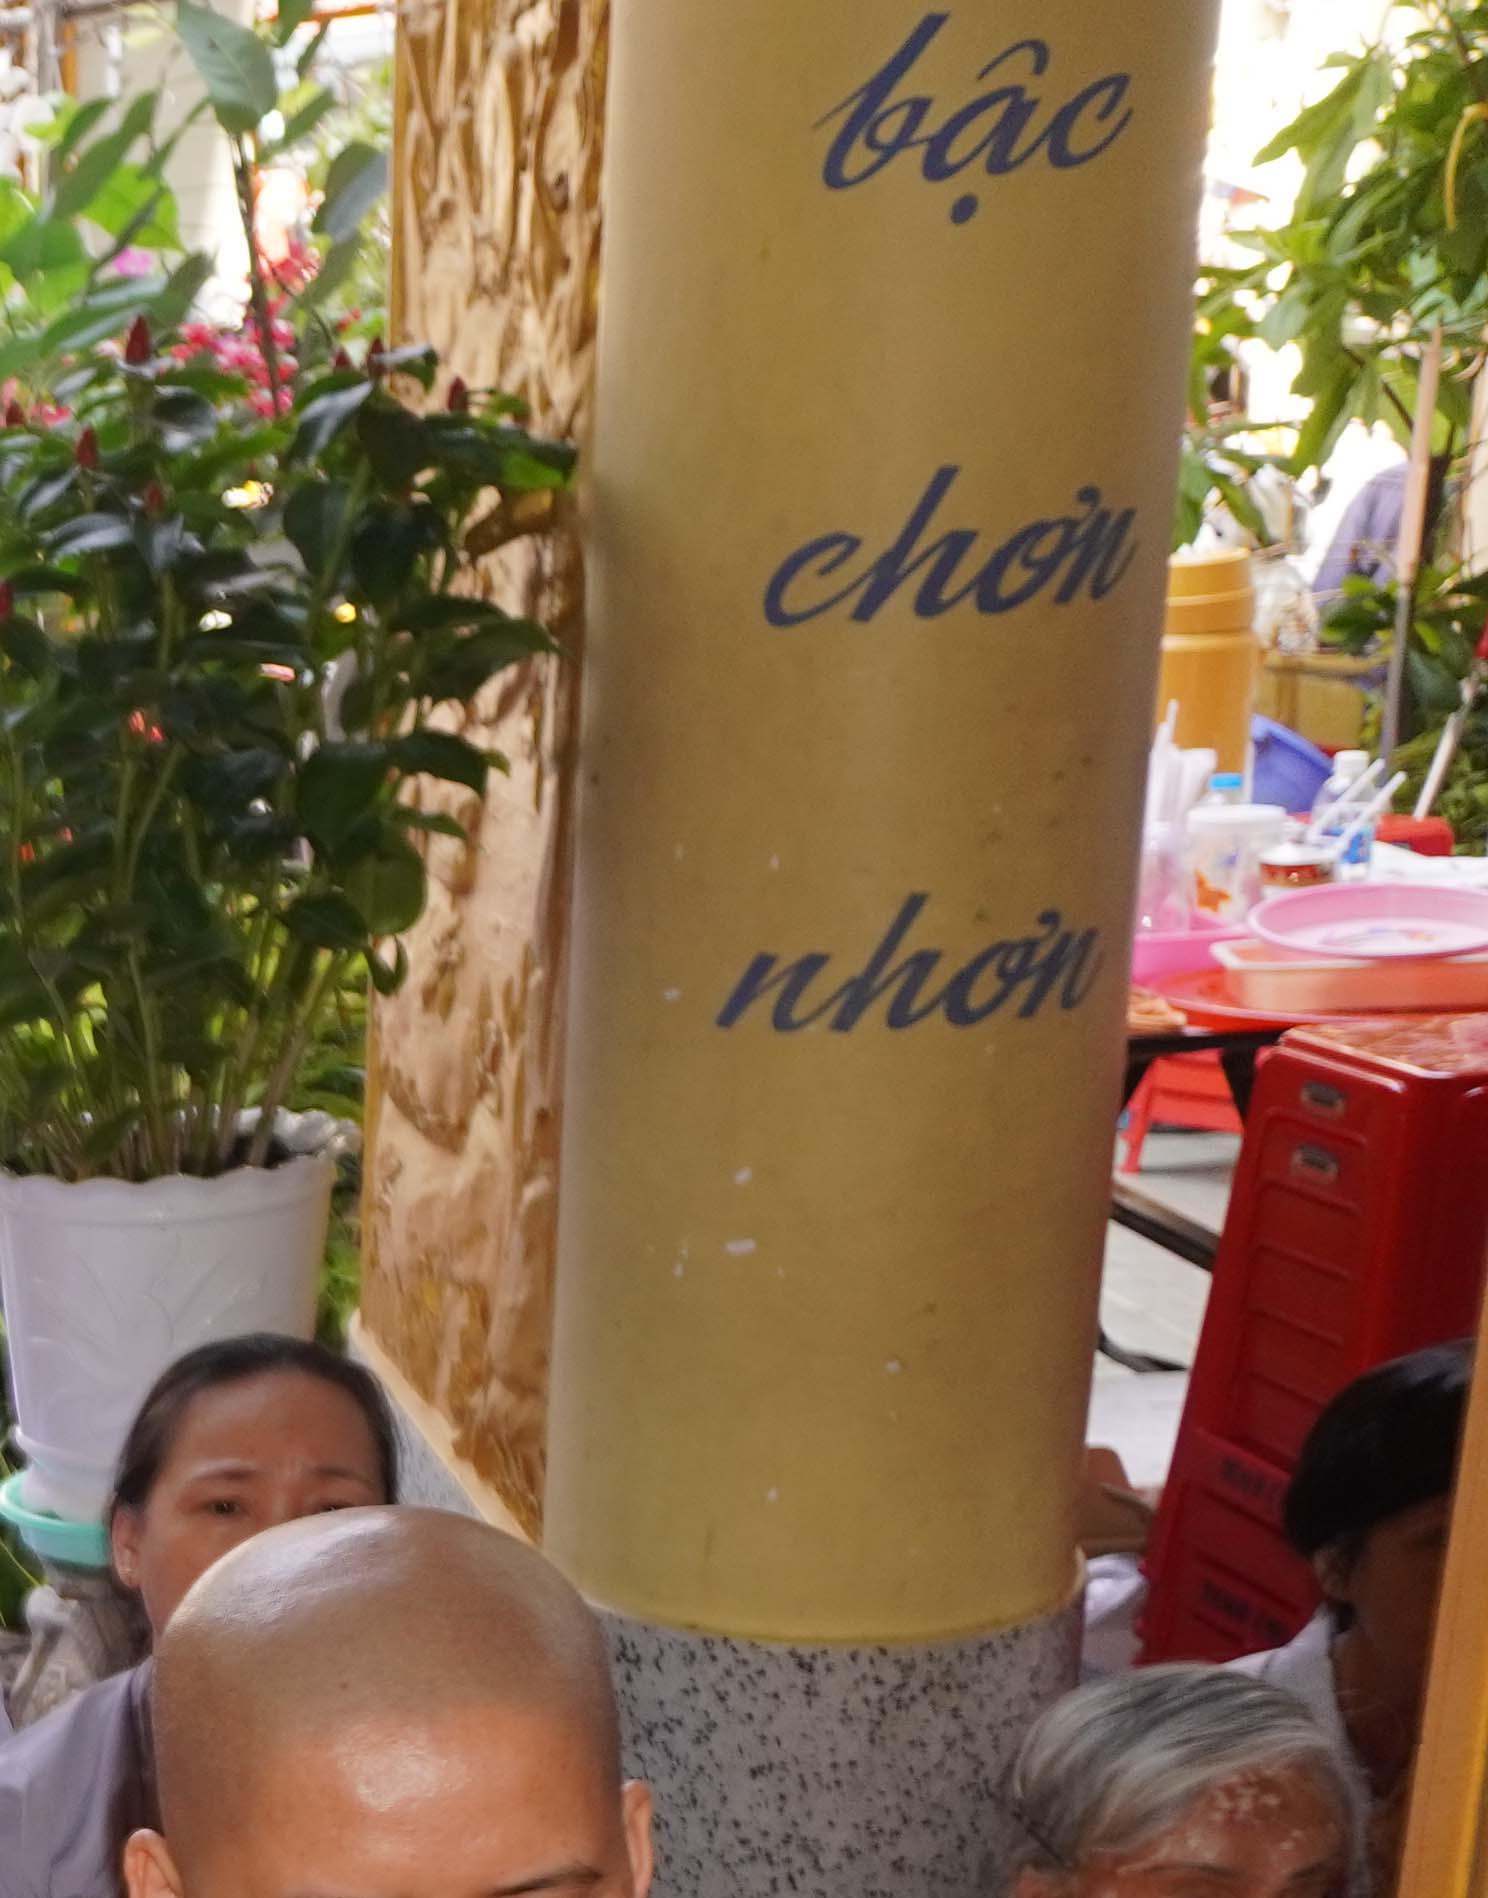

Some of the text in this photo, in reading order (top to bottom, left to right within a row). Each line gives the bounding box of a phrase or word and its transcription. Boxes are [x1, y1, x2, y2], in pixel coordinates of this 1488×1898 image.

[809, 9, 1135, 226] bậc
[763, 463, 1138, 628] chơn
[714, 892, 1106, 1034] nhơn
